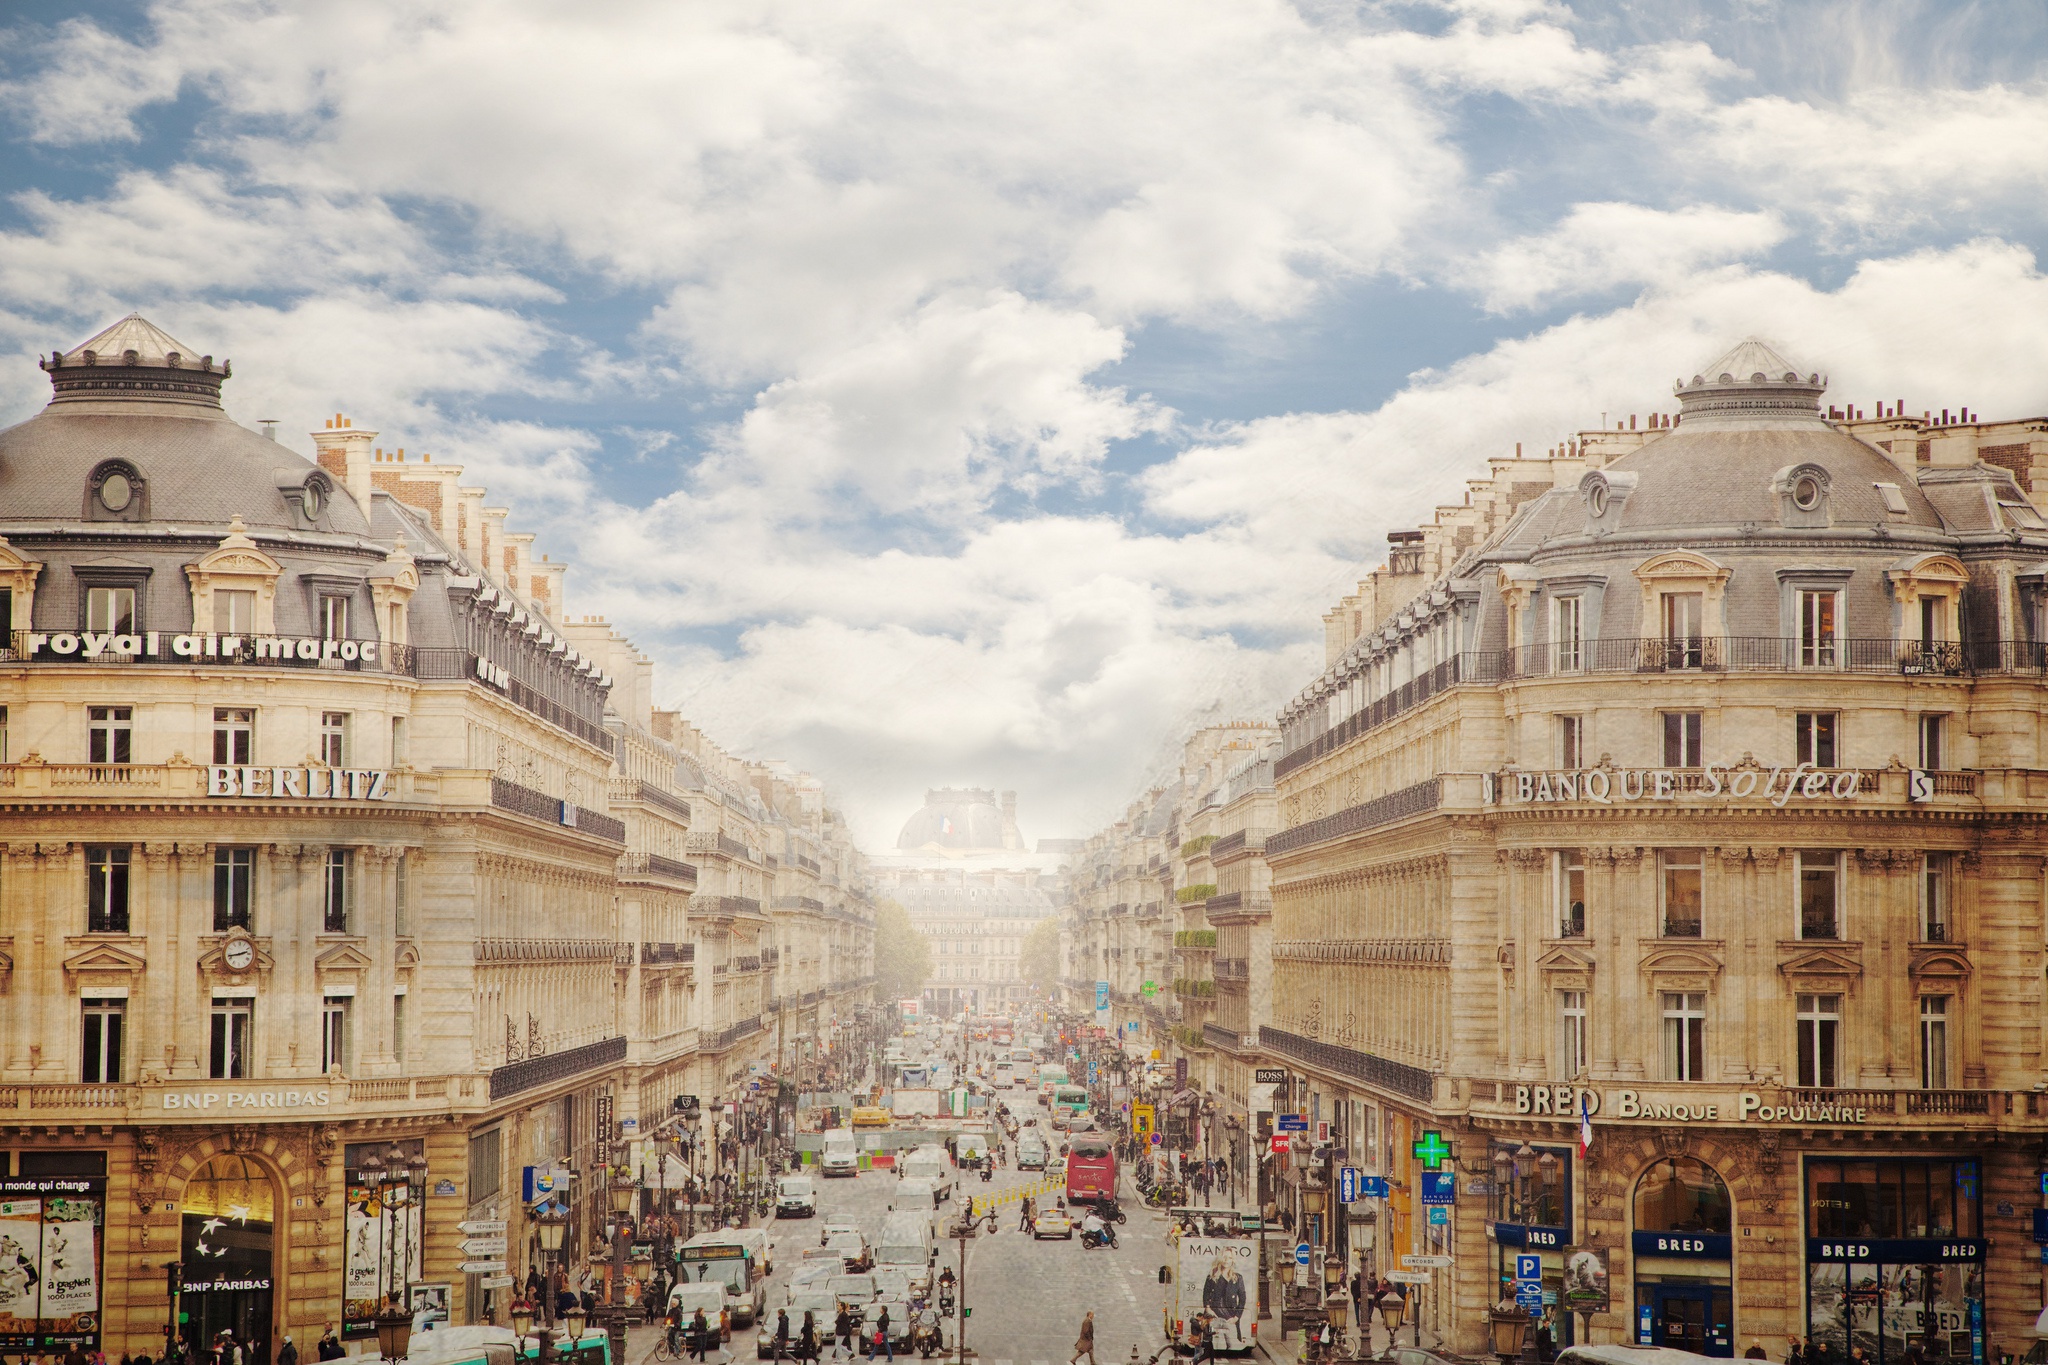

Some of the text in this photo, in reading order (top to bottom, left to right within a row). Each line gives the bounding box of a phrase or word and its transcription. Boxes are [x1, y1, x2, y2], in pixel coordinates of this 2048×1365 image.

[27, 631, 159, 657] royal
[172, 631, 242, 656] air
[256, 637, 376, 662] maroc
[1904, 666, 1924, 674] DEFI
[207, 766, 392, 800] BERLITZ
[1517, 771, 1677, 803] BANQUE
[1695, 761, 1861, 807] Solfea
[1257, 1071, 1283, 1079] BOSS
[163, 1090, 329, 1110] BNP PARIBAS
[1516, 1086, 1600, 1116] BRED
[5, 1180, 36, 1191] monde
[38, 1180, 53, 1192] qui
[55, 1180, 90, 1193] change
[1189, 1244, 1252, 1258] MANGO
[1658, 1238, 1705, 1252] BRED
[1822, 1244, 1870, 1257] BRED
[1942, 1245, 1976, 1257] BRED
[687, 1250, 698, 1258] 29
[1523, 1259, 1535, 1276] P
[183, 1280, 270, 1292] BNP PARIBAS
[1186, 1283, 1196, 1291] 39
[66, 1291, 92, 1299] PLACES
[1185, 1310, 1195, 1318] 34
[1916, 1310, 1961, 1330] BRED
